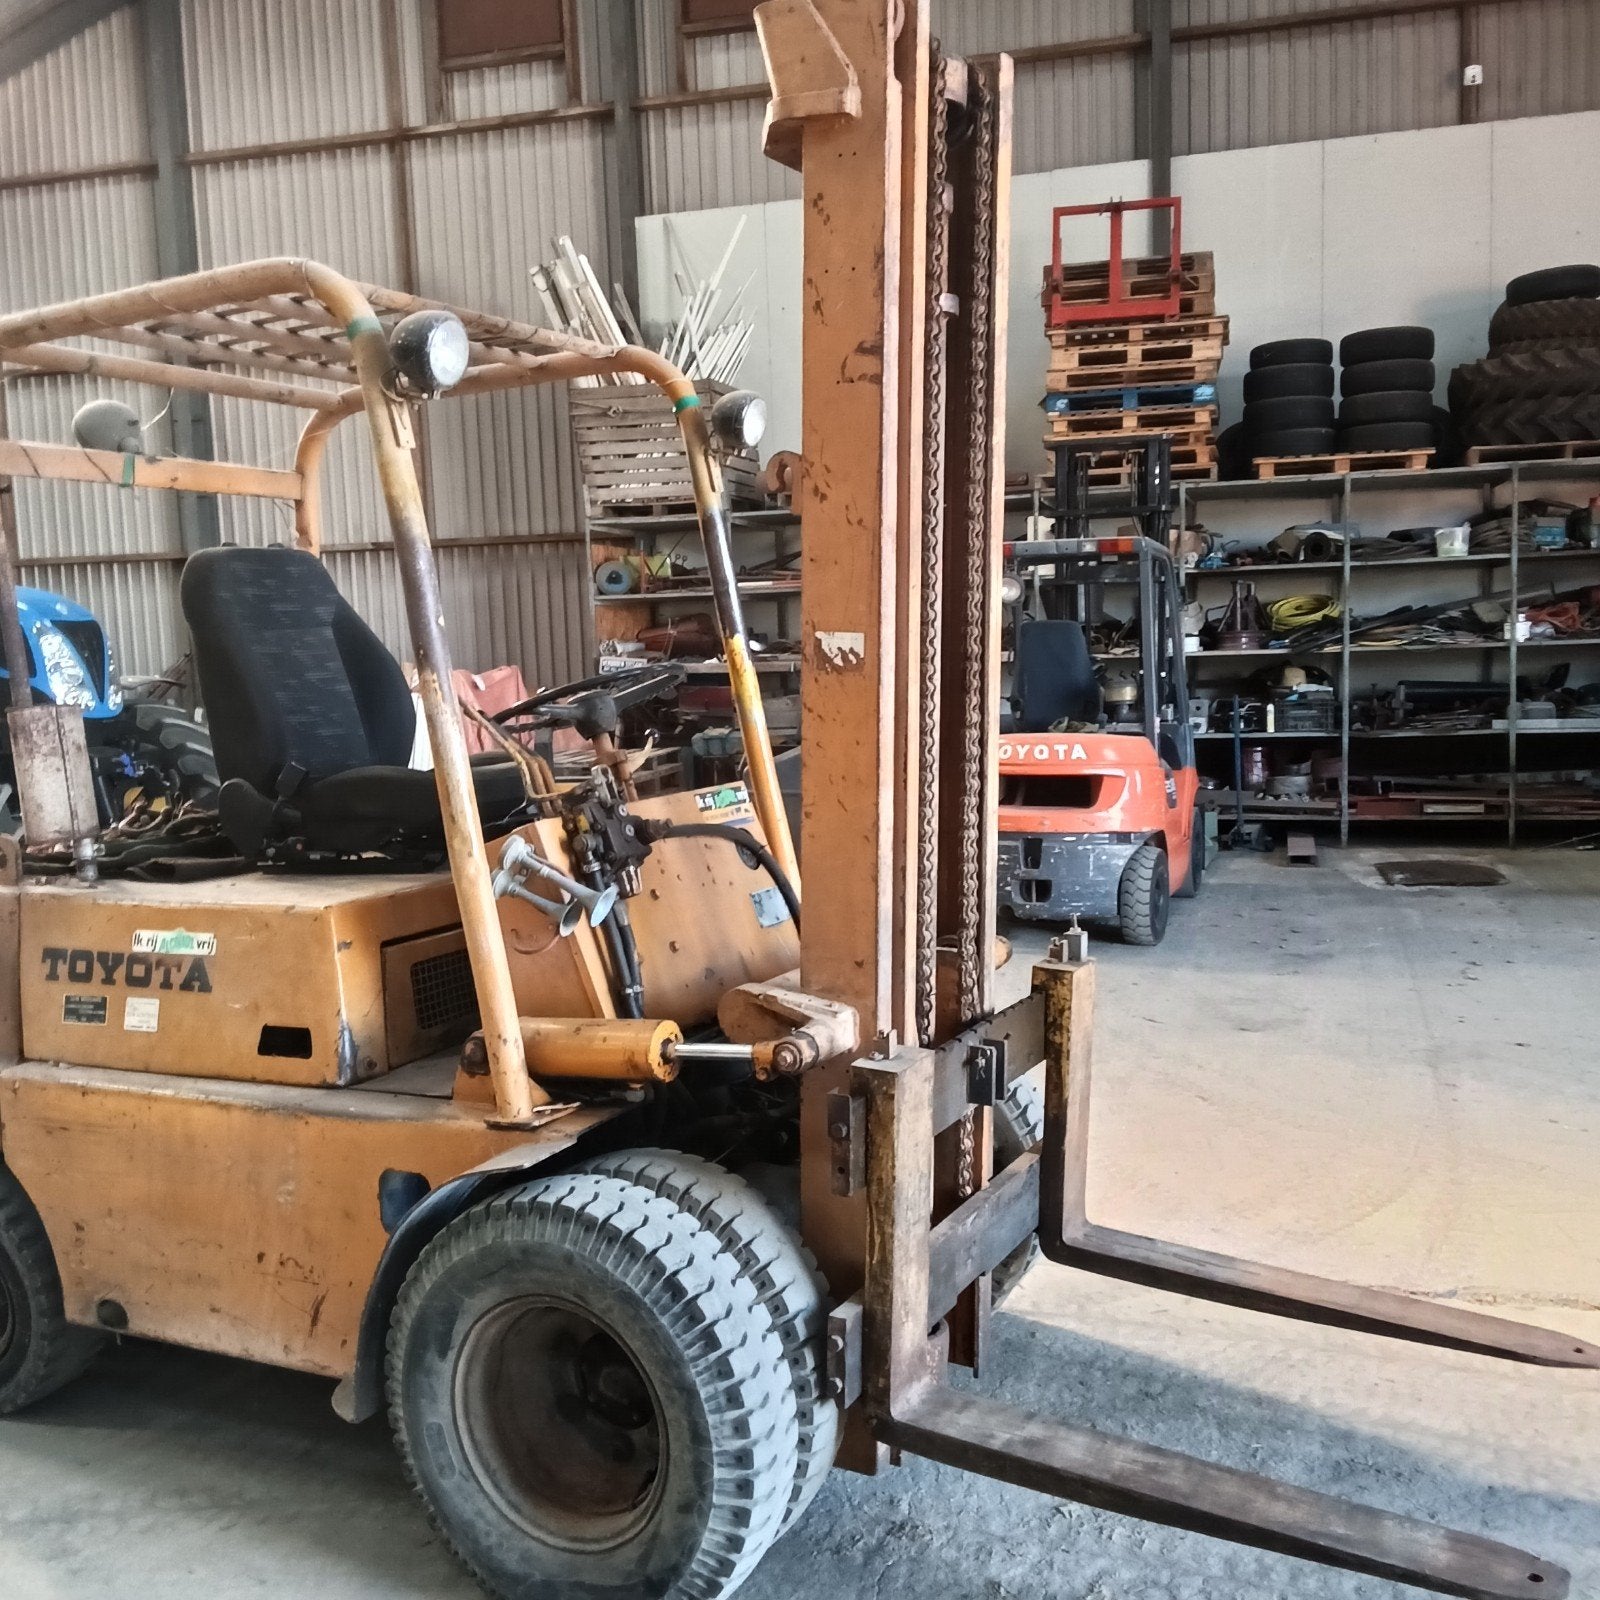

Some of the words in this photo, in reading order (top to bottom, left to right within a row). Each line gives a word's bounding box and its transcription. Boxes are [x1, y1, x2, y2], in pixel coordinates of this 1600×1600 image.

[999, 743, 1088, 760] OYOTA
[146, 933, 159, 953] rij
[196, 935, 215, 955] vrij
[41, 948, 213, 993] TOYOTA
